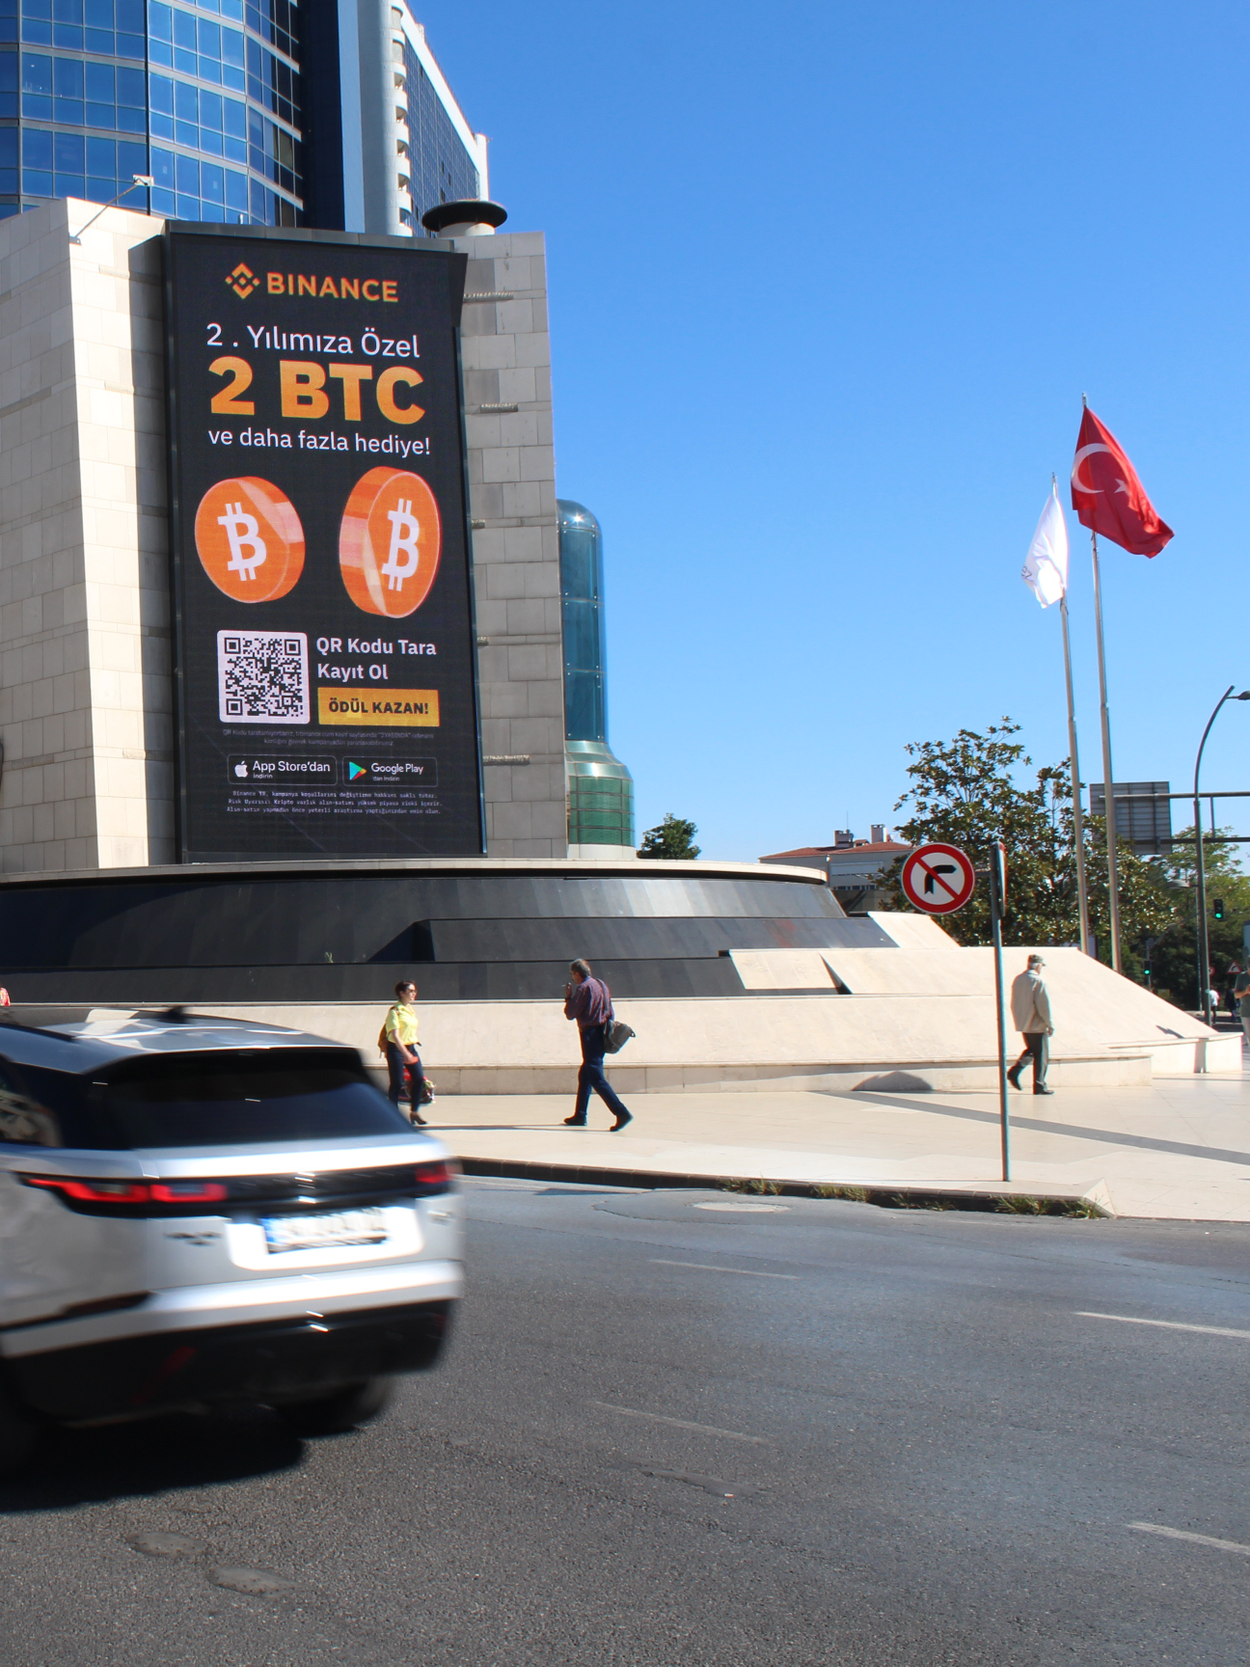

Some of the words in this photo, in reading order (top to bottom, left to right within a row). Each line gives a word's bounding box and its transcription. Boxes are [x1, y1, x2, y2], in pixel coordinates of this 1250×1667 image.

[267, 272, 399, 302] BINANCE
[247, 325, 354, 354] Yılımıza
[361, 327, 421, 358] Özel
[208, 355, 255, 416] 2
[279, 360, 426, 425] BTC
[208, 430, 233, 446] ve
[239, 427, 293, 448] daha
[298, 430, 349, 451] fazla
[355, 433, 431, 458] hediye!
[316, 637, 342, 656] QR
[347, 638, 393, 654] Kodu
[398, 639, 437, 655] Tara
[317, 663, 364, 682] Kayıt
[368, 664, 388, 680] Ol
[329, 697, 368, 713] ÖDÜL
[372, 702, 429, 715] KAZAN!
[252, 760, 276, 773] App
[278, 760, 331, 772] Store'dan
[371, 763, 404, 775] Google
[405, 763, 424, 775] Play
